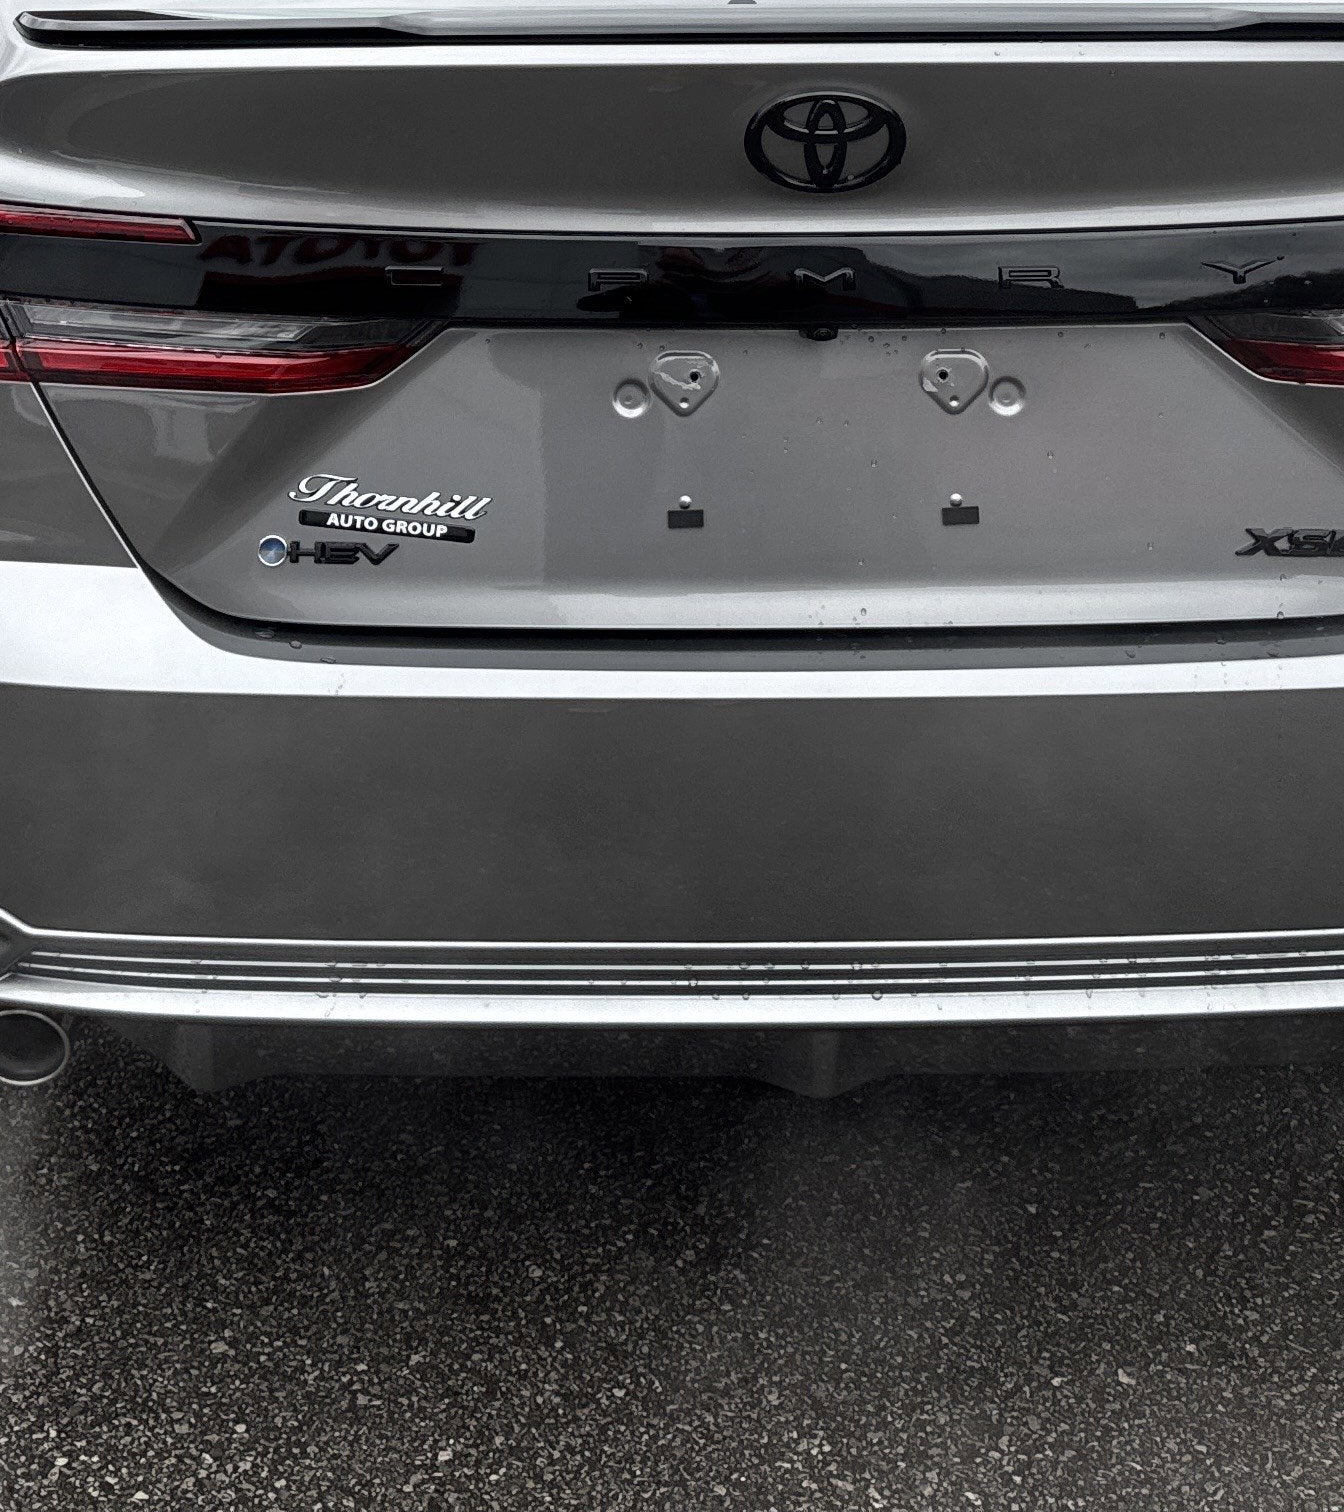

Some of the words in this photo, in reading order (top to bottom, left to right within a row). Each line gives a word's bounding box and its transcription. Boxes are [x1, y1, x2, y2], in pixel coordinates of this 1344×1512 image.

[288, 474, 494, 520] Thornhill
[326, 513, 380, 530] AUTO
[382, 518, 448, 538] GROUP
[287, 540, 400, 565] HEV
